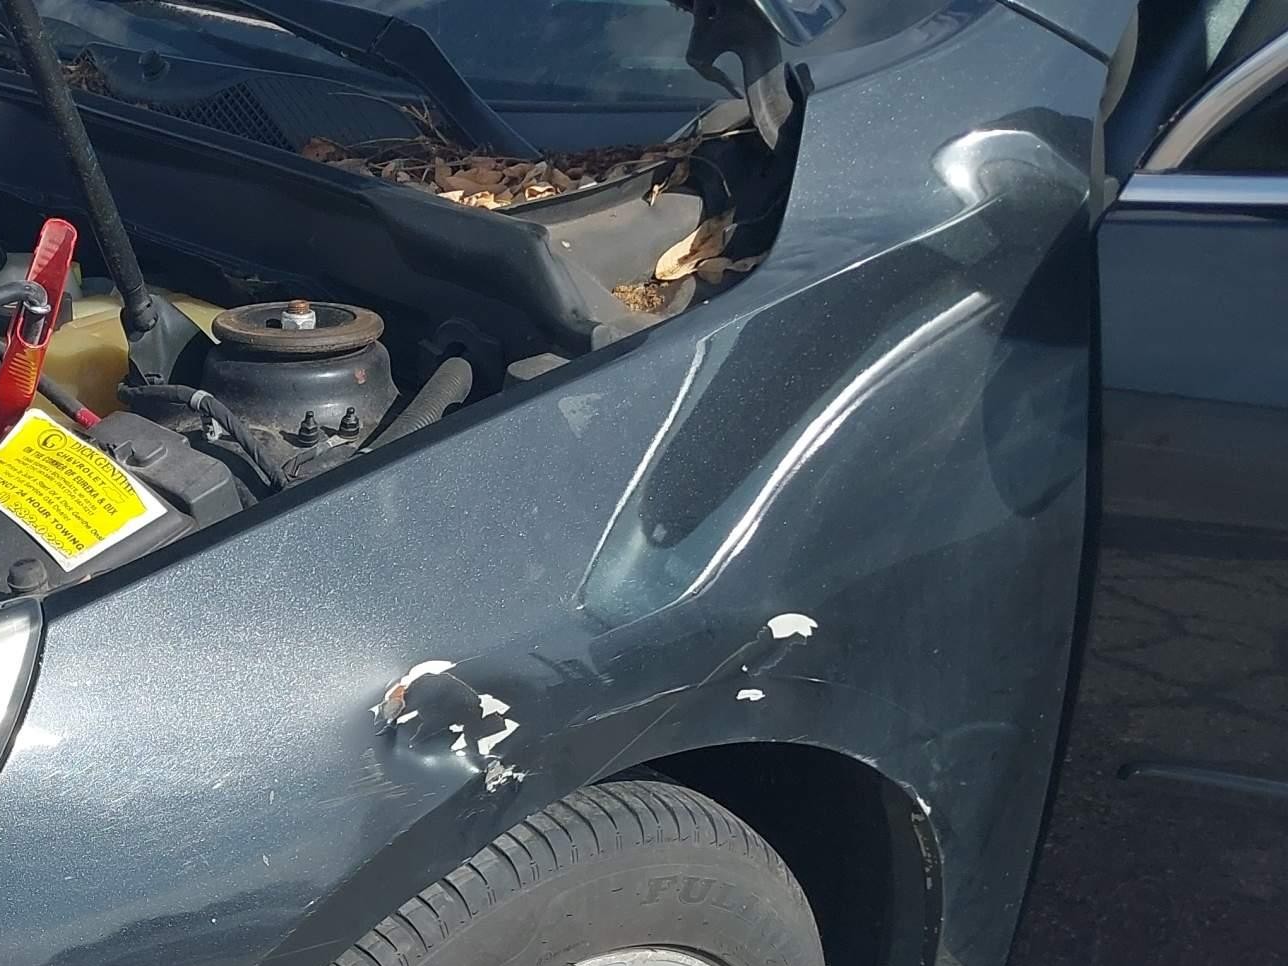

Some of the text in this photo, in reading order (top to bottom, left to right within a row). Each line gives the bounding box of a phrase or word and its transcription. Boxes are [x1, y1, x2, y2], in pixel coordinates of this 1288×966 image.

[55, 450, 106, 488] CHEVROLET
[69, 441, 98, 461] DICK
[41, 455, 67, 472] CORNER
[63, 468, 76, 477] OF
[71, 474, 100, 499] EUREKA
[96, 496, 106, 505] &
[102, 502, 118, 517] DIX
[14, 488, 28, 498] 24
[25, 495, 51, 519] HOUR
[50, 518, 85, 551] TOWING
